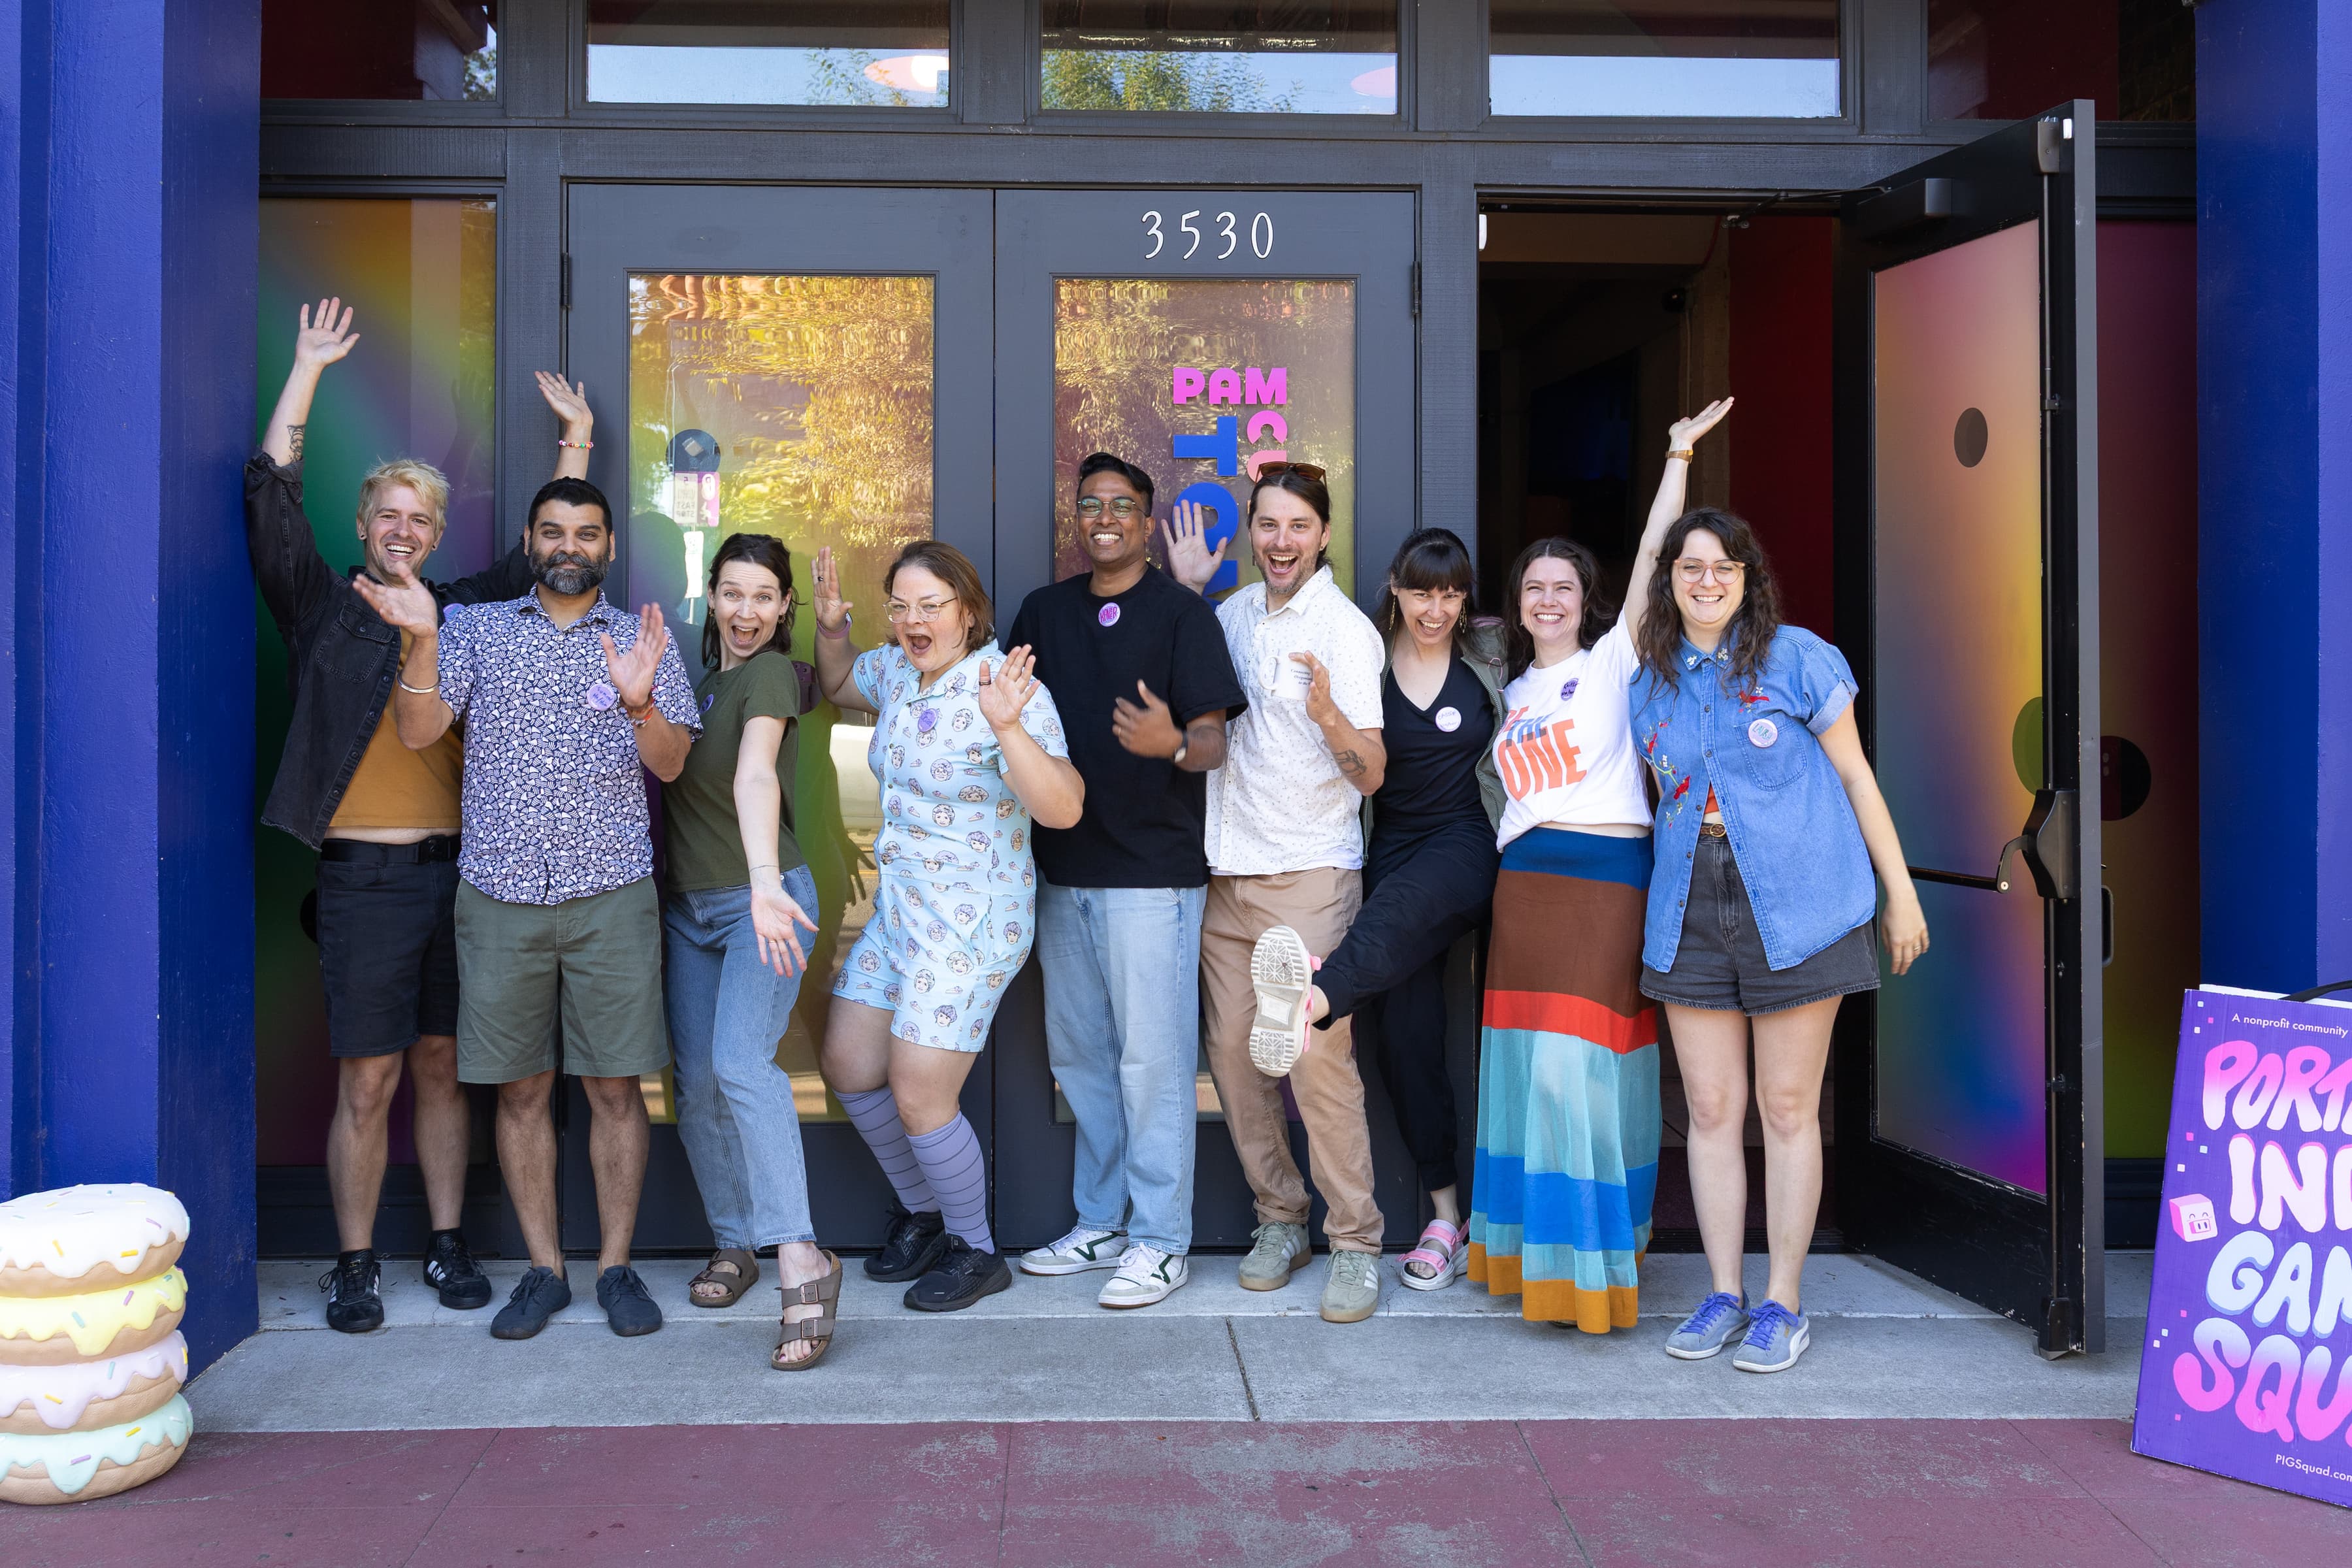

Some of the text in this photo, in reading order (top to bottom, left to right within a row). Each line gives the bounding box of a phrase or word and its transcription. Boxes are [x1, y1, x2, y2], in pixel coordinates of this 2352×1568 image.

[1142, 210, 1274, 259] 3530
[1173, 367, 1287, 404] PAM
[1506, 711, 1556, 748] THE
[1497, 719, 1587, 802] ONE
[2232, 1013, 2348, 1038] A nonprofit community
[2202, 1040, 2352, 1135] PORT
[2172, 1317, 2352, 1447] SQU
